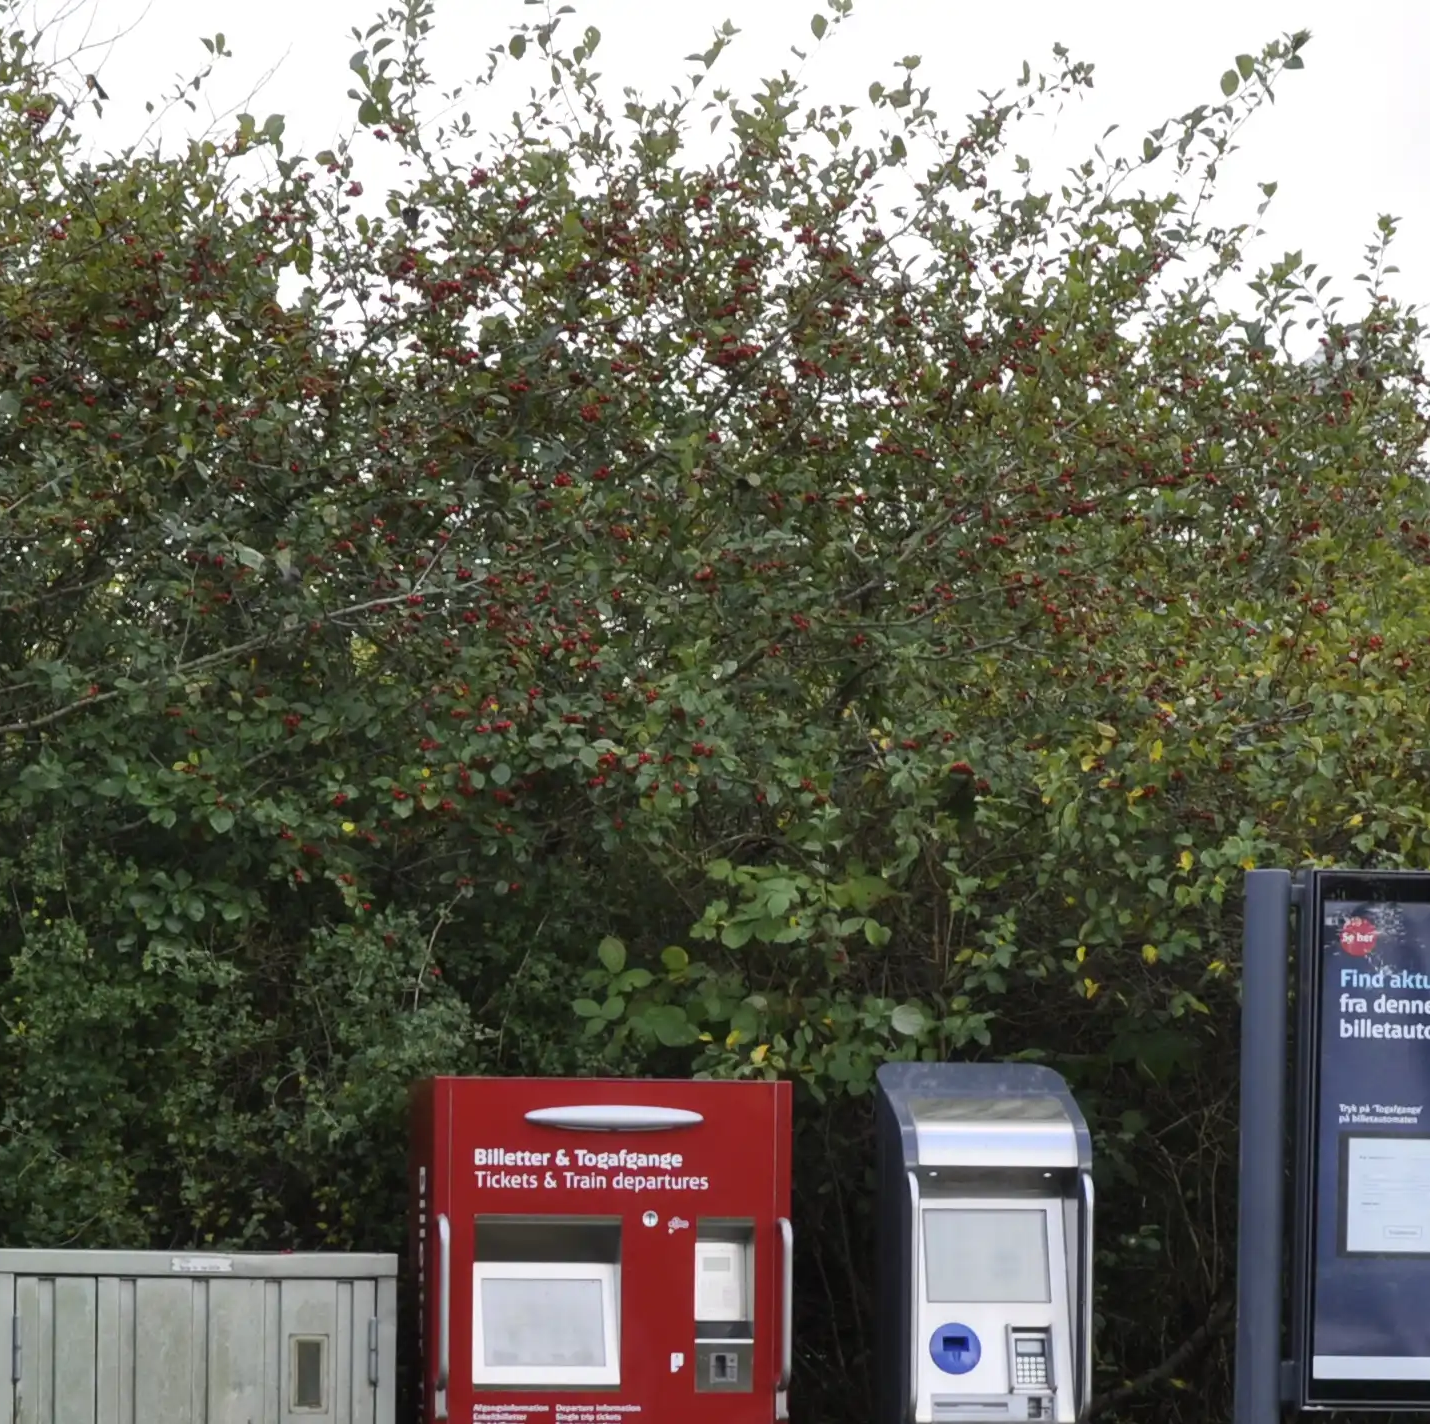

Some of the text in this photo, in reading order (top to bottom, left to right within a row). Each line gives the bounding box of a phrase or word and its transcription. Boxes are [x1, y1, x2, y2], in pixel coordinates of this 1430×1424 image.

[1356, 932, 1374, 942] her
[1340, 969, 1384, 988] Find
[1339, 993, 1367, 1013] fra
[1338, 1103, 1357, 1114] Tryk
[1359, 1104, 1370, 1114] på
[1339, 1114, 1418, 1124] på billetautomaten
[474, 1147, 683, 1170] Billetter & Togafgange
[474, 1170, 709, 1193] Tickets & Train departures
[555, 1404, 594, 1413] Departure
[595, 1404, 642, 1412] information
[555, 1413, 580, 1422] Single
[580, 1413, 595, 1422] trip
[595, 1413, 622, 1421] tickets
